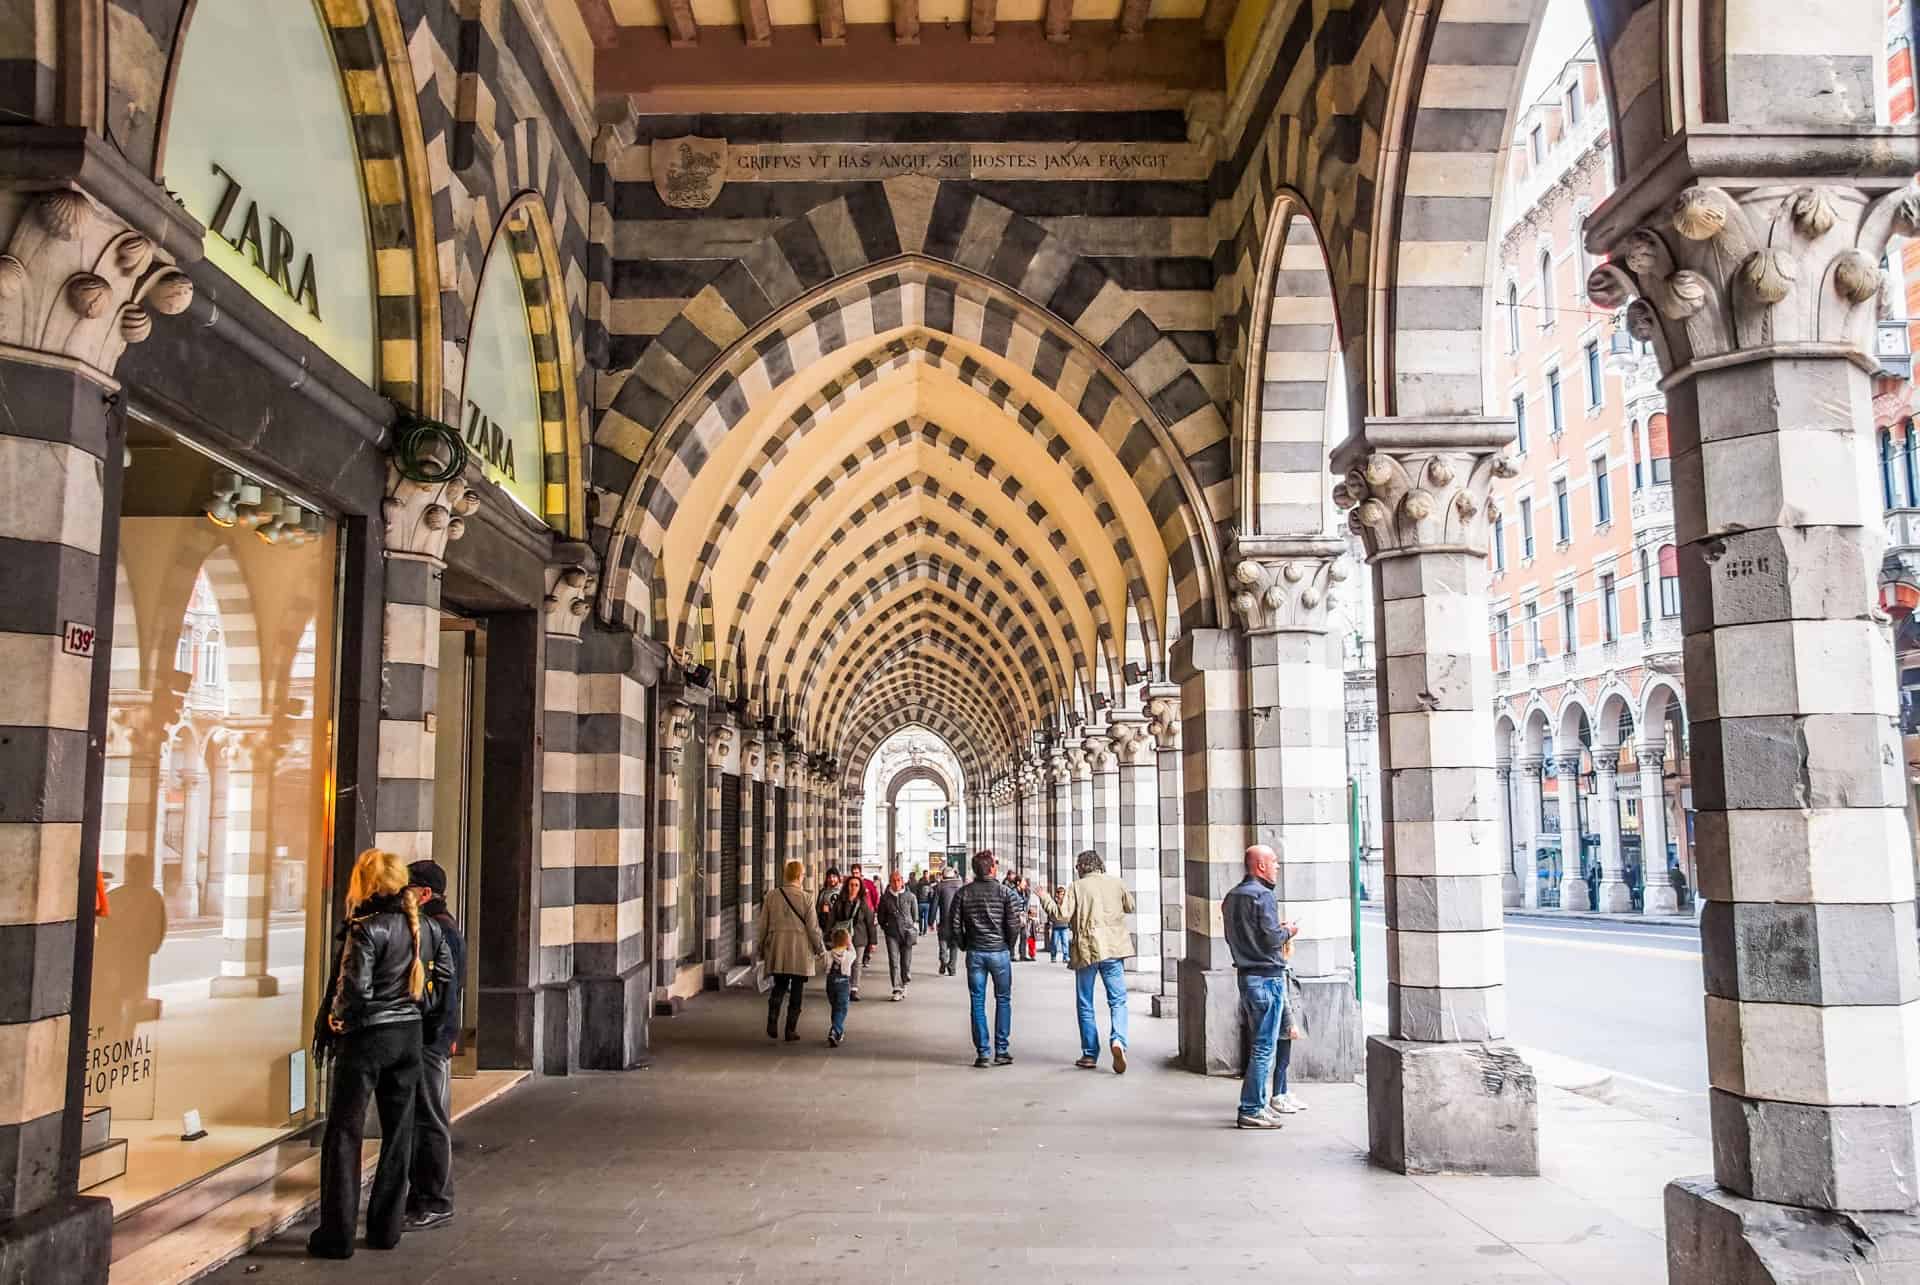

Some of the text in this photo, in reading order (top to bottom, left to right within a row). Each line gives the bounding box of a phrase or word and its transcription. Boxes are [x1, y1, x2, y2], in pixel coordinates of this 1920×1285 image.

[808, 155, 833, 169] VT
[838, 155, 871, 169] HAS
[936, 153, 964, 169] SIC
[971, 154, 1037, 169] HOSTES
[1042, 154, 1091, 171] JANVA
[1098, 153, 1169, 170] FRANGIT
[209, 162, 322, 323] ZARA
[466, 399, 517, 484] ZARA
[84, 1034, 152, 1073] ERSONAL
[83, 1057, 151, 1097] HOPPER
